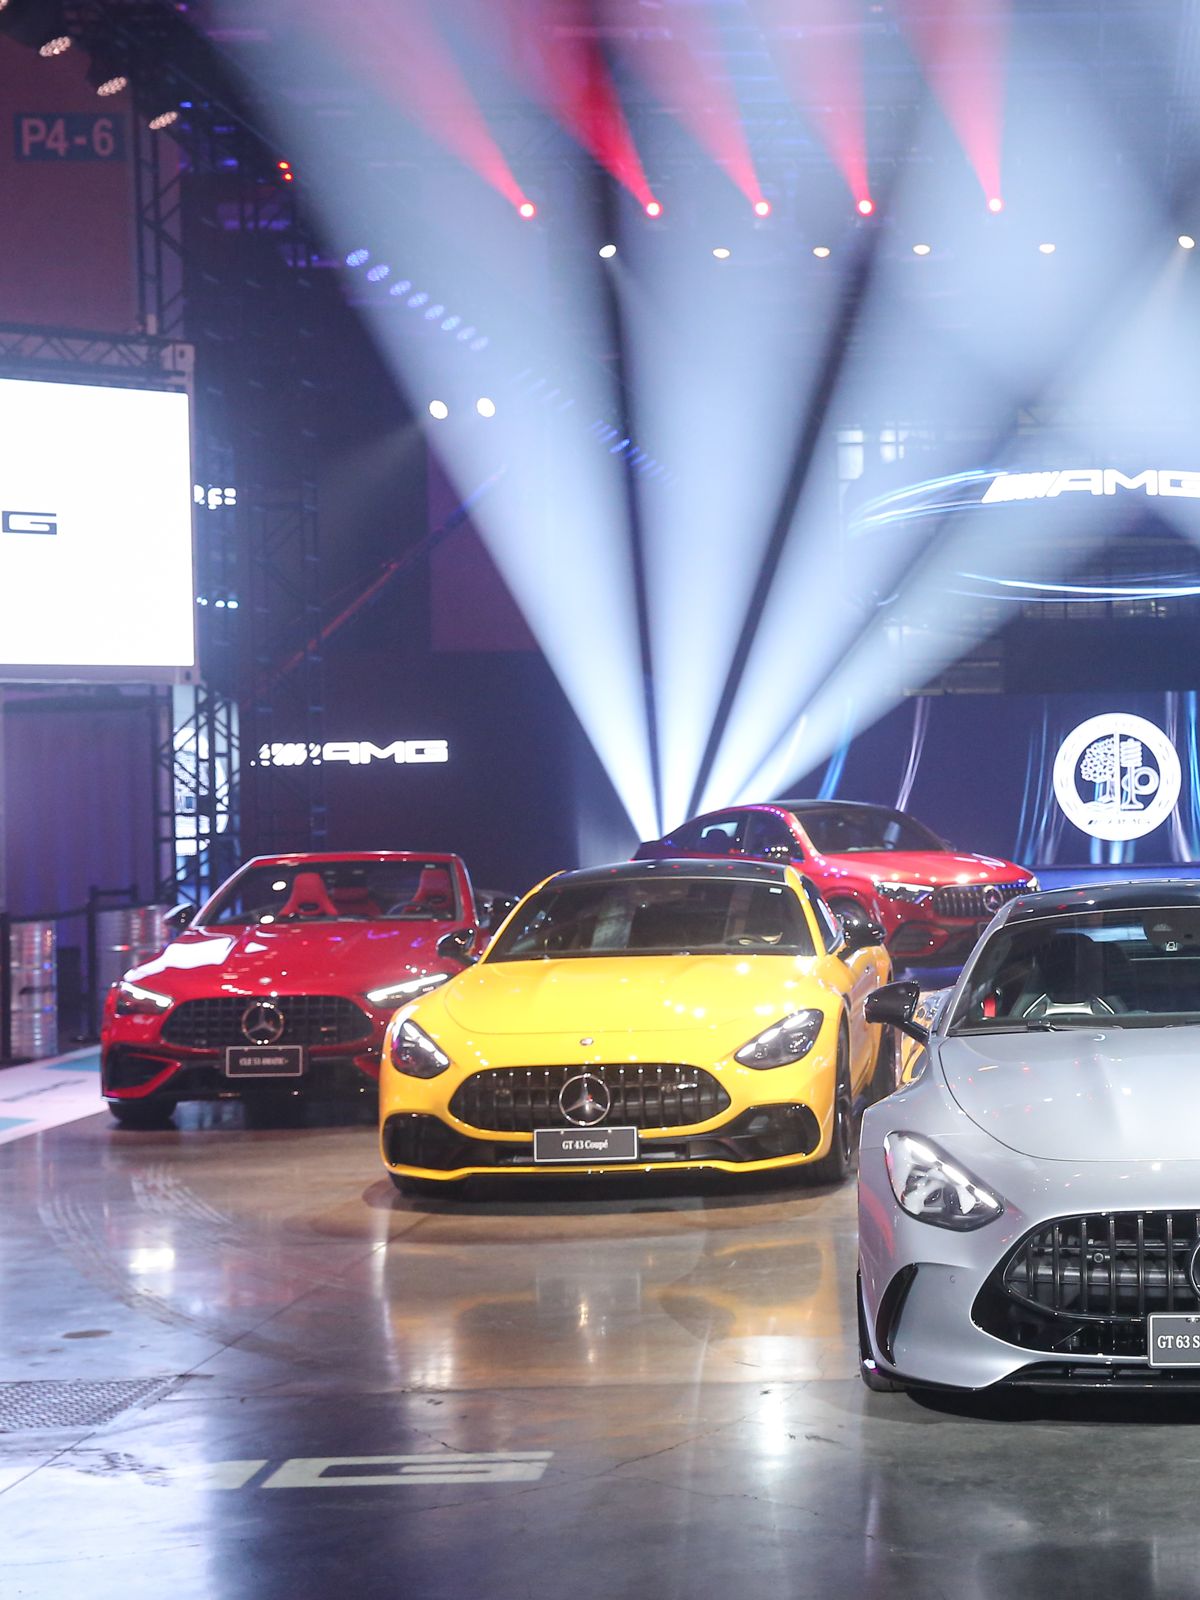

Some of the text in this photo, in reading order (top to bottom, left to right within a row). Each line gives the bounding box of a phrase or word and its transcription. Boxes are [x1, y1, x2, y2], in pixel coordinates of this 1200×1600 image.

[22, 118, 114, 157] P4-6
[562, 1140, 574, 1150] GT
[1157, 1335, 1174, 1348] GT
[1175, 1335, 1190, 1348] 63
[1192, 1335, 1200, 1348] S
